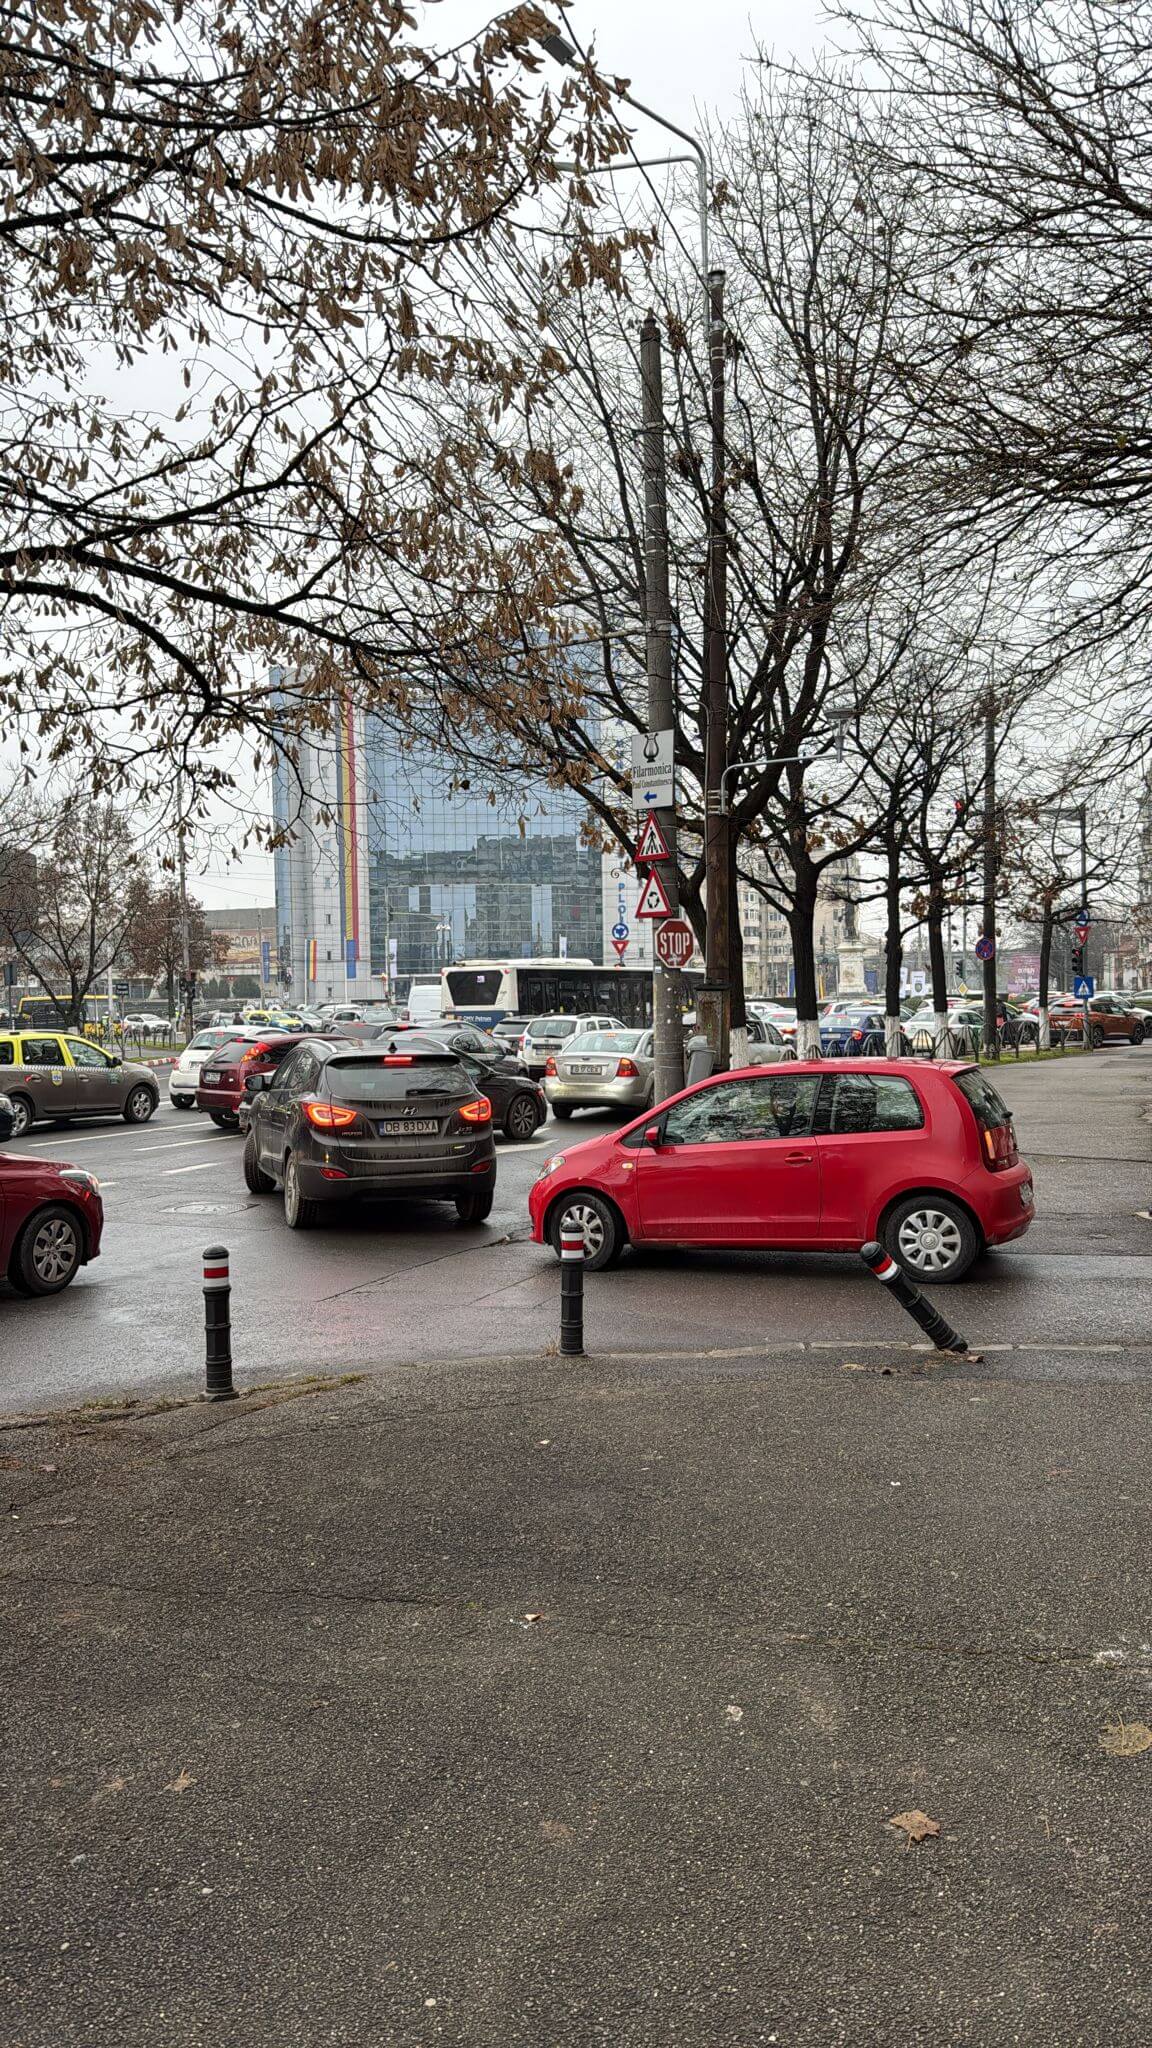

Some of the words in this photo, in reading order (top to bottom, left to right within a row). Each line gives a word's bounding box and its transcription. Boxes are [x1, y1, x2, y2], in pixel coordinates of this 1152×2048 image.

[633, 763, 672, 778] Filarmonica
[660, 932, 690, 955] STOP
[385, 1122, 400, 1133] DB
[403, 1121, 415, 1131] 83
[417, 1120, 438, 1131] DXA
